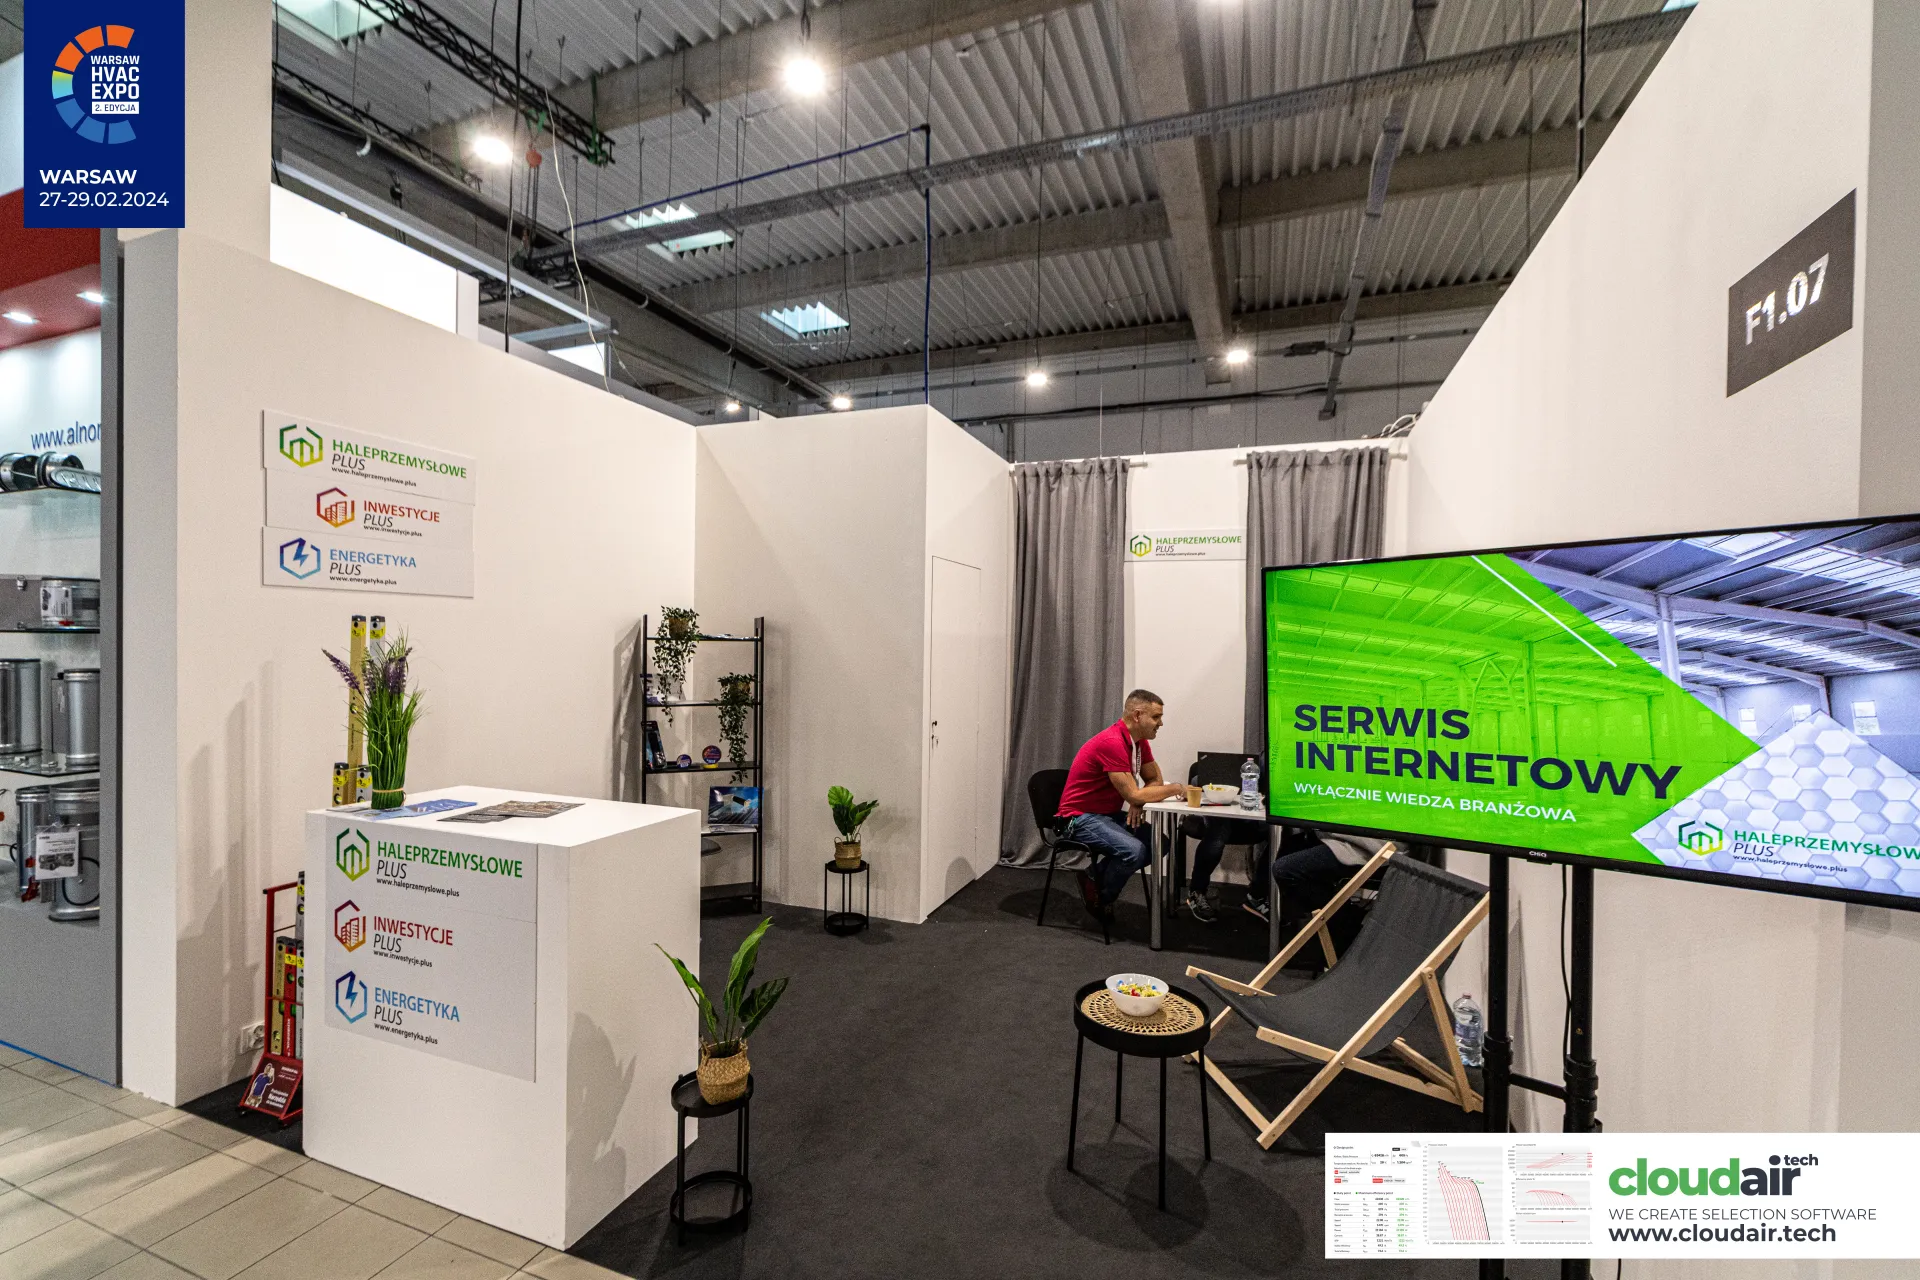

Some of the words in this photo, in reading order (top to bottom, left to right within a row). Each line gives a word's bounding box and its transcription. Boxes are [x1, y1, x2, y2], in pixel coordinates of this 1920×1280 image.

[1746, 252, 1829, 346] F1.07
[332, 439, 467, 478] HALEPRZEMYSŁOWE
[332, 453, 365, 471] PLUS
[331, 466, 417, 487] www.haleprzemyslowe.plus
[364, 500, 440, 523] INWESTYCJE
[364, 514, 393, 528] PLUS
[364, 525, 422, 537] www.inwestycje.plus
[1156, 536, 1242, 545] HALEPRZEMYSŁOWE
[330, 549, 417, 568] ENERGETYKA
[1155, 545, 1175, 553] PLUS
[330, 562, 361, 576] PLUS
[330, 575, 397, 585] www.energetyka.plus
[1294, 704, 1470, 740] SERWIS
[1295, 741, 1683, 800] INTERNETOWY
[1293, 782, 1382, 802] WYŁĄCZNIE
[1385, 791, 1455, 810] WIEDZA
[1459, 799, 1576, 823] BRANŻOWA
[377, 840, 523, 878] HALEPRZEMYSŁOWE
[1733, 842, 1774, 857] PLUS
[377, 860, 407, 879] PLUS
[1733, 855, 1848, 873] www.haleprzemyslowe.plus
[376, 877, 460, 897] www.haleprzemyslowe.plus
[374, 915, 453, 946] INWESTYCJE
[373, 933, 402, 953] PLUS
[373, 949, 433, 968] www.inwestycje.plus
[375, 986, 460, 1023] ENERGETYKA
[374, 1005, 403, 1026] PLUS
[374, 1022, 438, 1045] www.energetyka.plus
